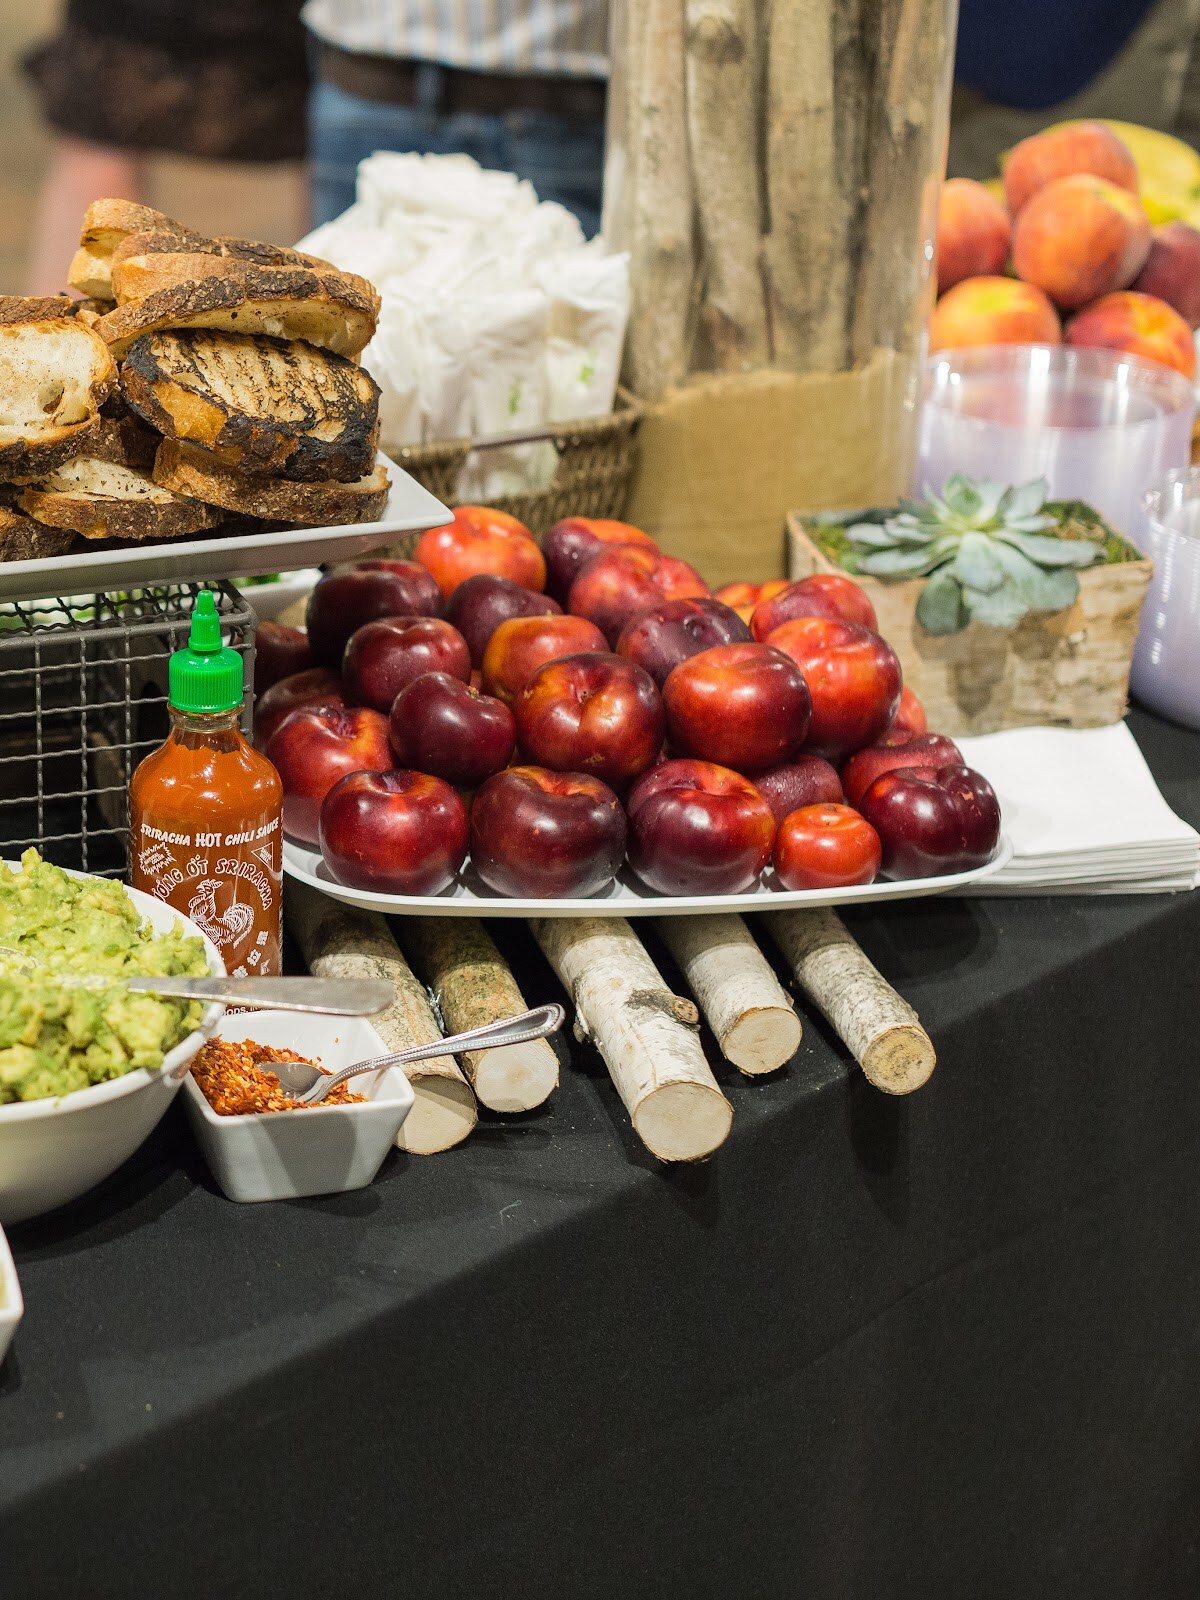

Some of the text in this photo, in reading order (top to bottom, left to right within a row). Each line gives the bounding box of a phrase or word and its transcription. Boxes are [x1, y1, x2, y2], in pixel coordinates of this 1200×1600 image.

[140, 817, 279, 848] SRIRACHA HOT CHILI SAUCE
[215, 858, 273, 911] SRIRACHA
